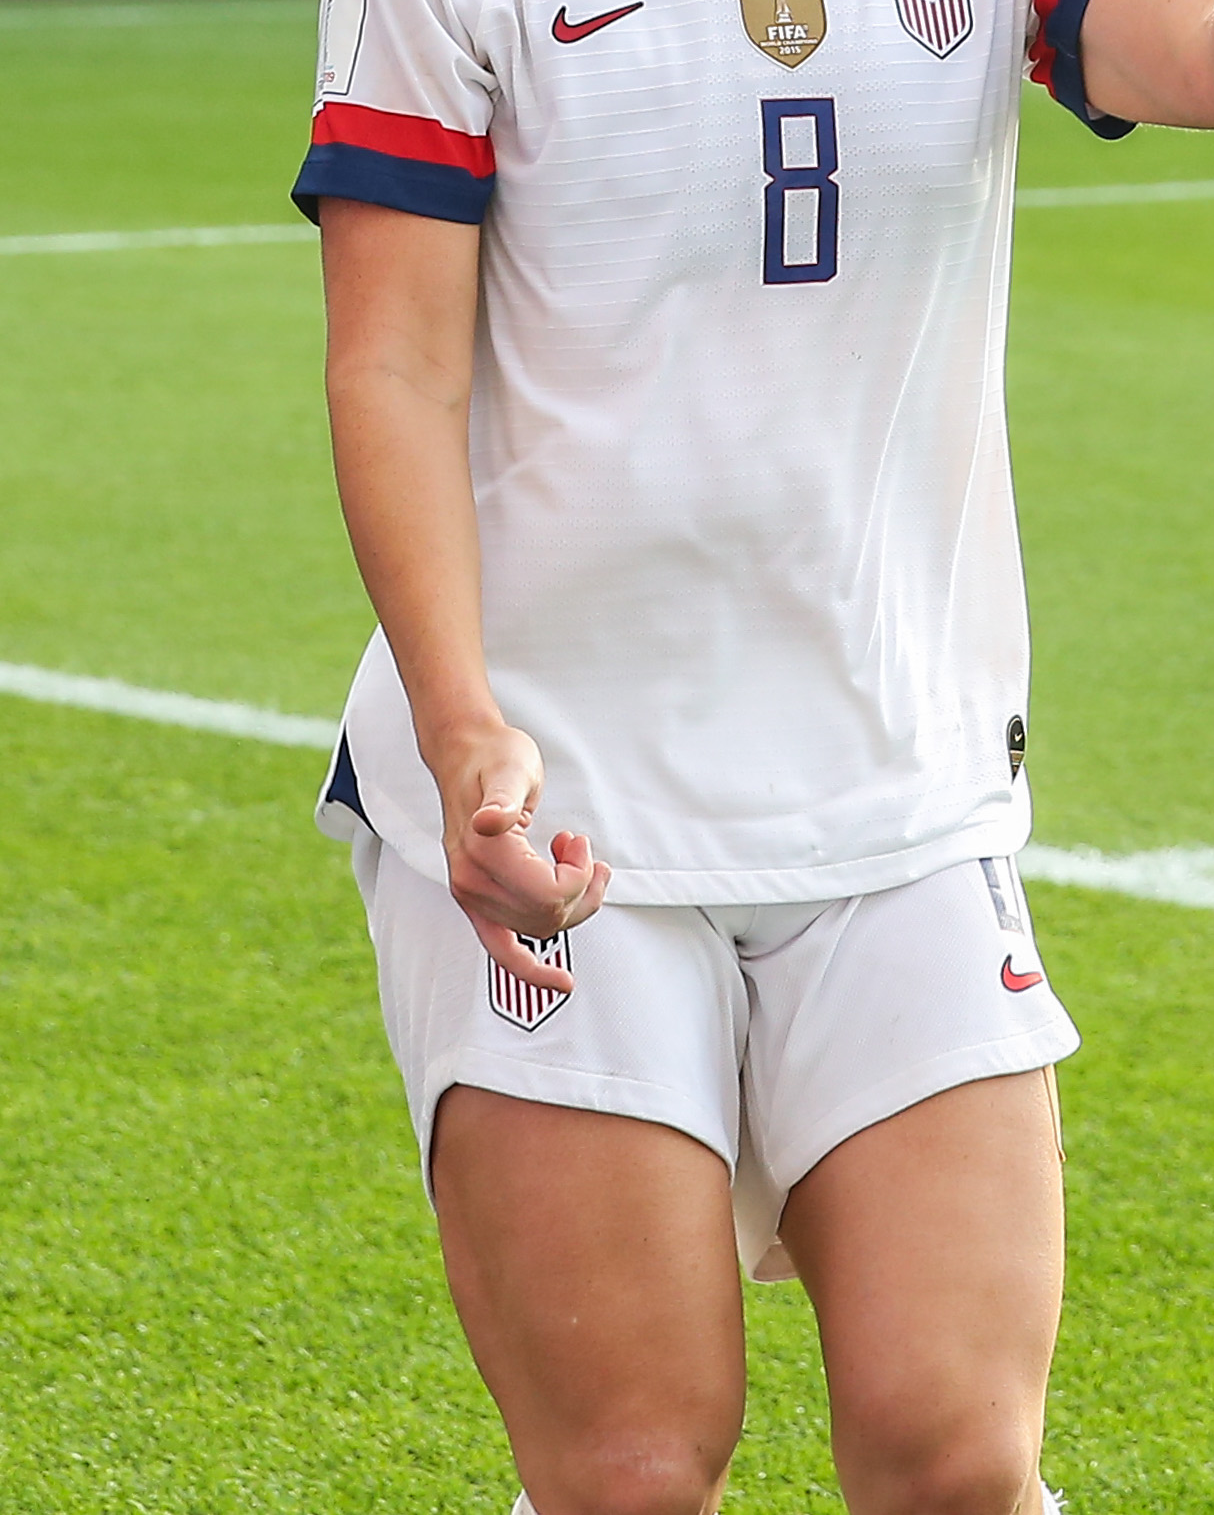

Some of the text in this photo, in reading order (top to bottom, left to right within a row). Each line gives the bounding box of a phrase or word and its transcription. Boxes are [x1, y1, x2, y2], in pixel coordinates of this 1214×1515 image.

[767, 25, 807, 41] FIFA
[779, 46, 801, 55] 2015
[760, 97, 840, 286] 8
